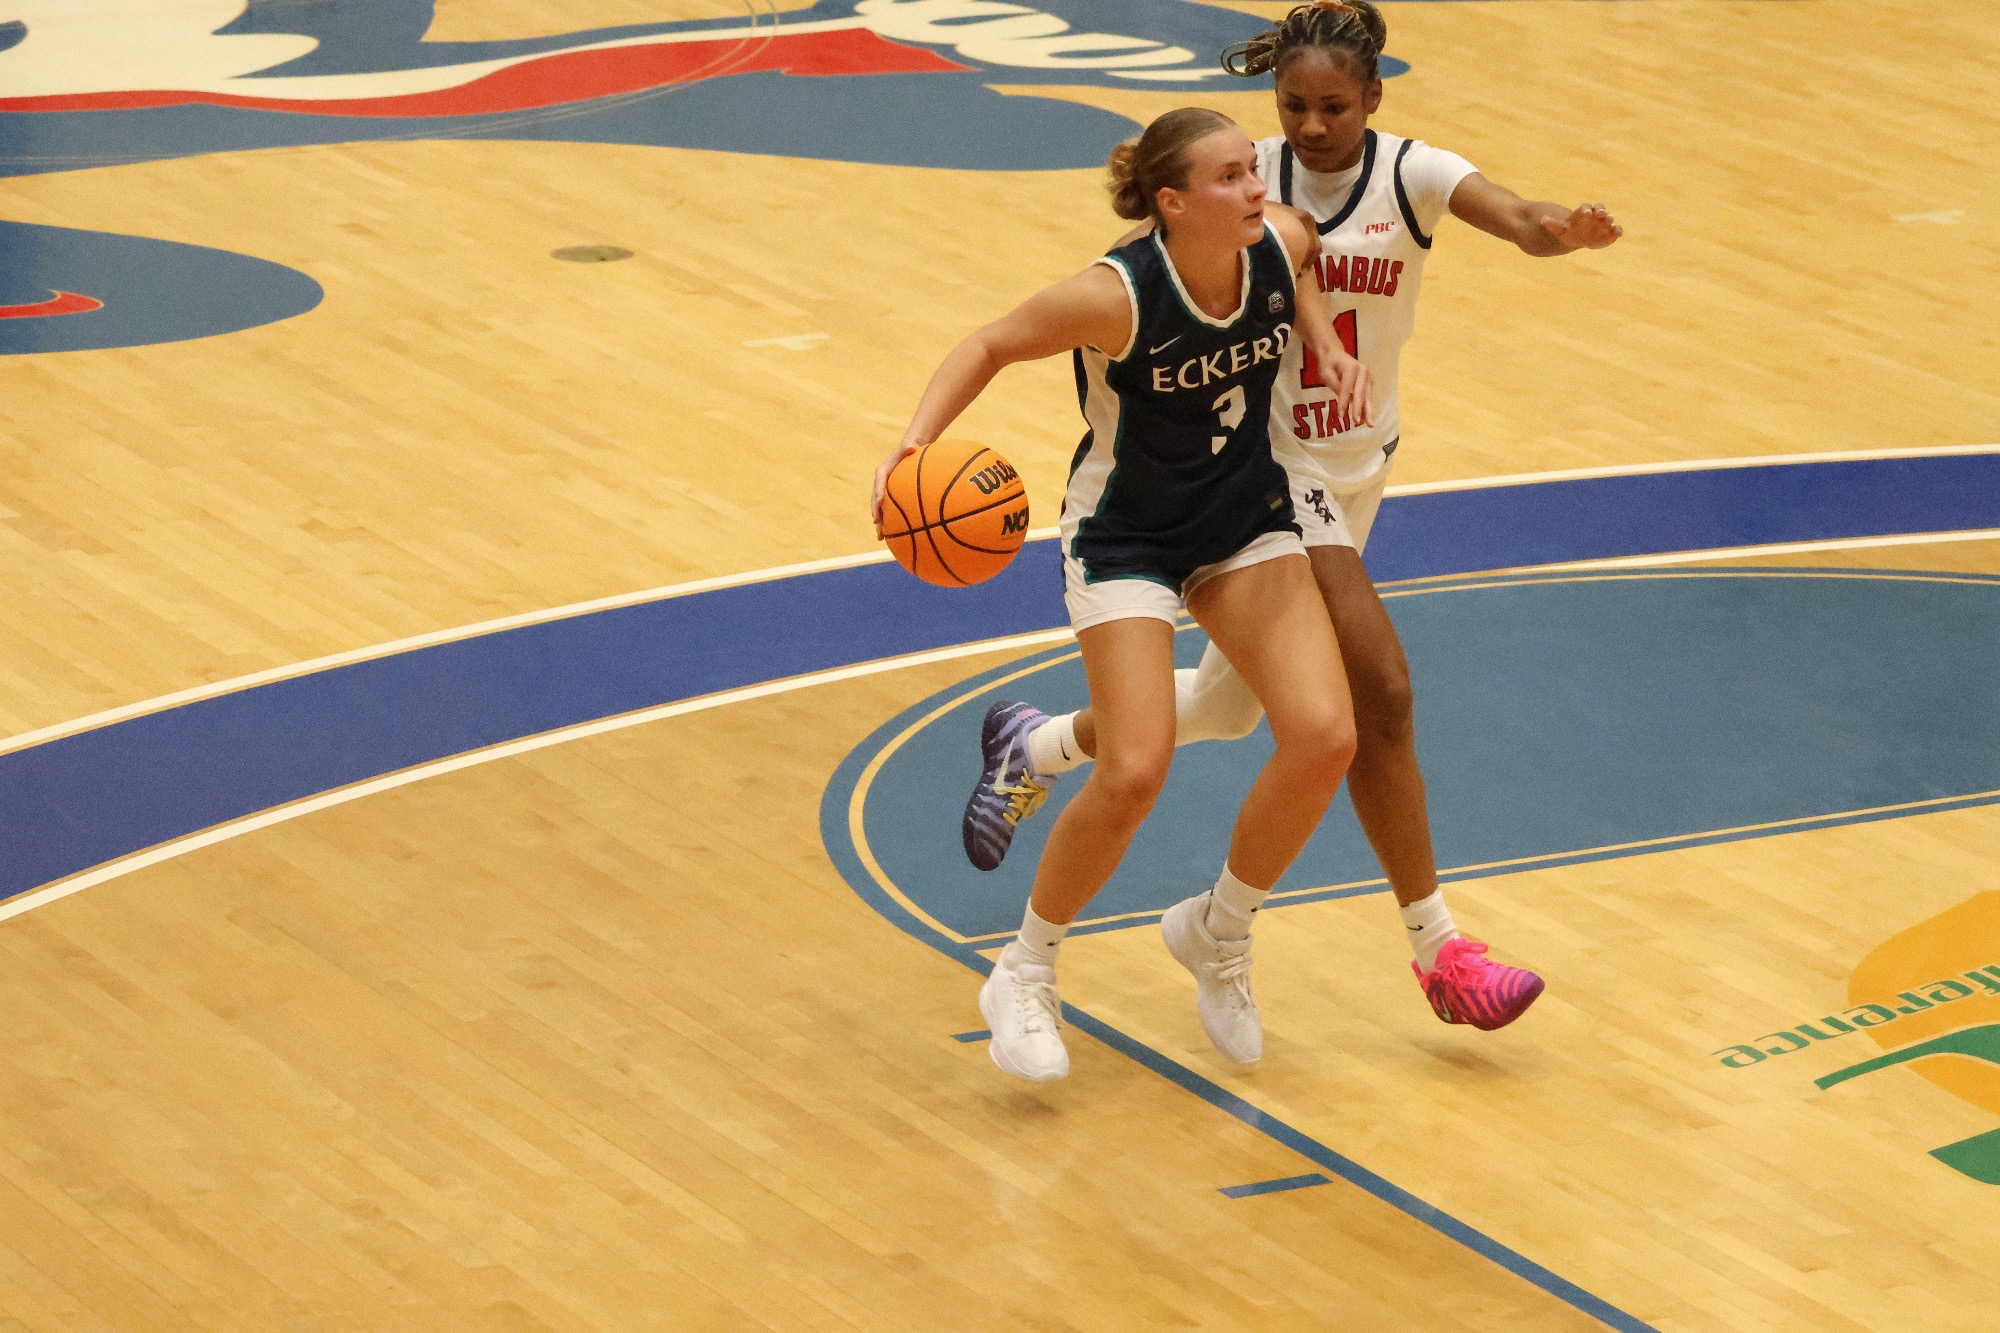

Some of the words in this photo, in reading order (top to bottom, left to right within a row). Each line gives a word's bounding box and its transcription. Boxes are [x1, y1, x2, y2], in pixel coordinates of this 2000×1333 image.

[1365, 221, 1395, 235] PBC
[1152, 322, 1292, 392] ECKERD
[1211, 384, 1247, 456] 3
[1292, 399, 1367, 440] STA
